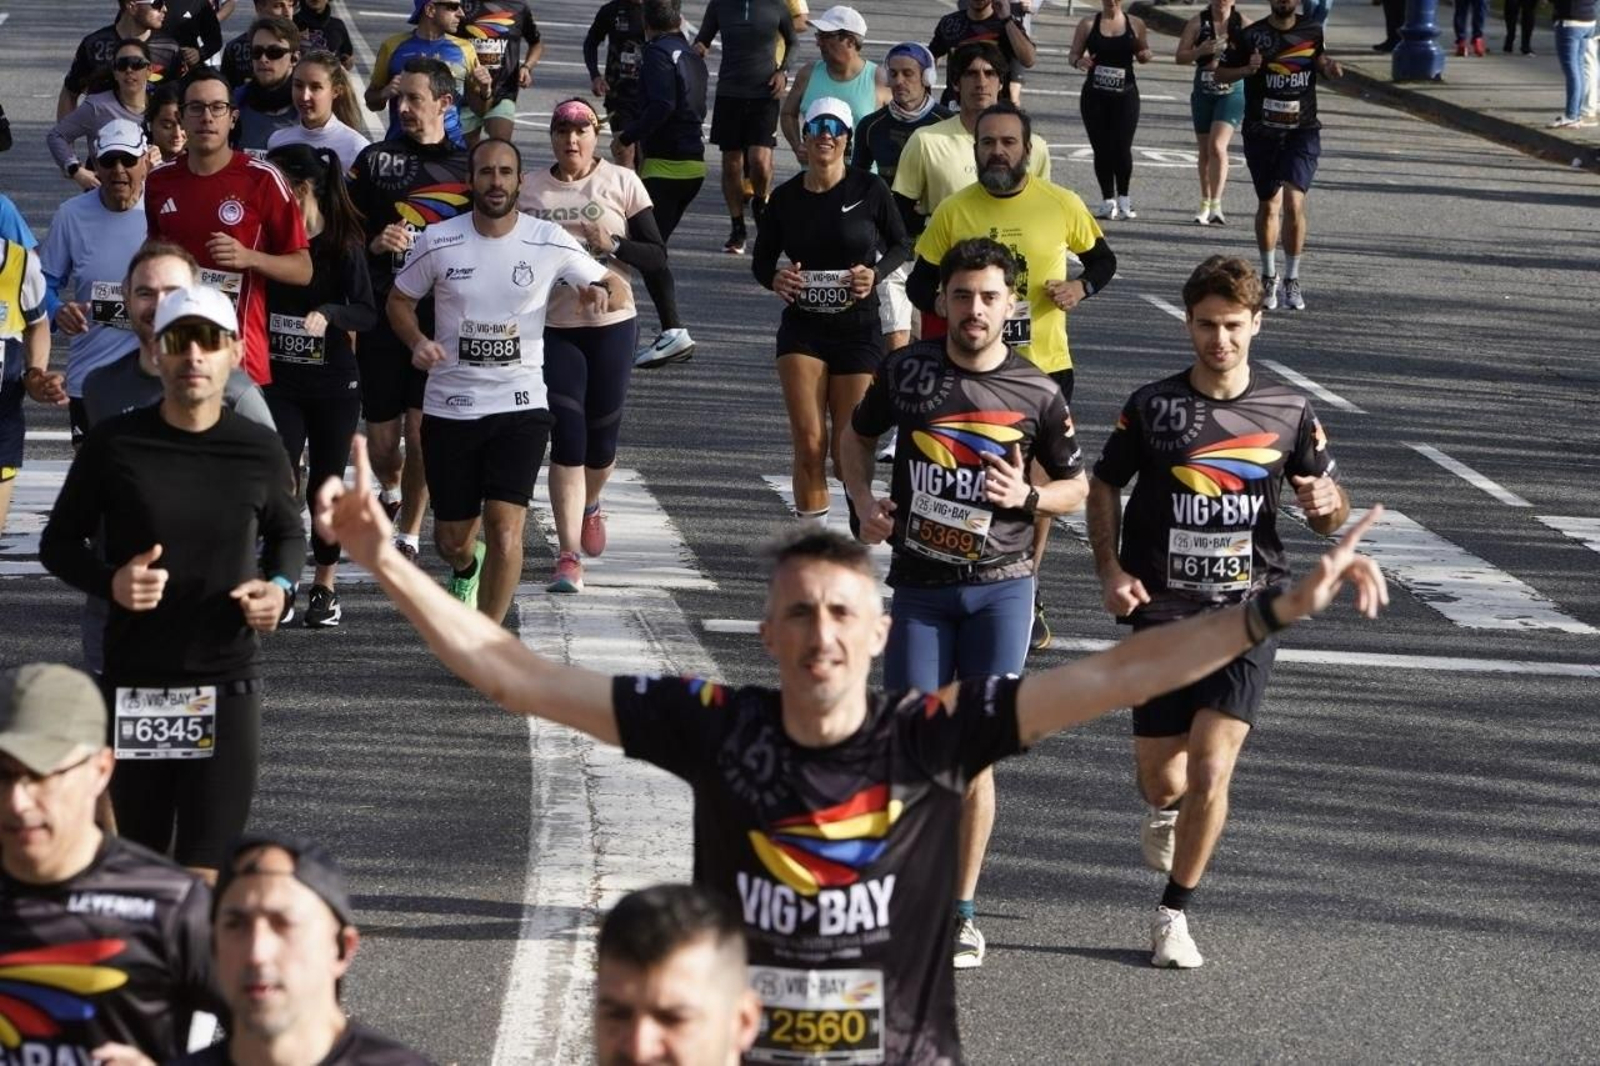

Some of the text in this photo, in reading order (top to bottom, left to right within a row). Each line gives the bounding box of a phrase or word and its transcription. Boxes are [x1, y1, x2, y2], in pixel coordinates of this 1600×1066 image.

[1266, 70, 1311, 89] VIG BAY
[379, 152, 405, 176] 25
[211, 272, 226, 283] BAY
[808, 288, 847, 303] 6090
[477, 323, 489, 333] VIG
[493, 323, 508, 333] BAY
[279, 335, 316, 353] 1984
[470, 340, 515, 357] 5988
[900, 358, 939, 396] 25
[514, 391, 530, 406] BS
[1151, 396, 1187, 432] 25
[909, 459, 987, 502] VIG BA
[919, 499, 971, 520] 25 VIG BAY
[1172, 493, 1264, 526] VIG BAY
[920, 520, 974, 553] 5369
[1193, 536, 1208, 548] VIG
[1213, 536, 1232, 548] BAY
[1184, 556, 1241, 577] 6143
[170, 692, 191, 706] BAY
[136, 717, 203, 742] 6345
[737, 871, 896, 936] VIG BAY
[820, 978, 848, 997] BAY
[771, 1009, 866, 1045] 2560
